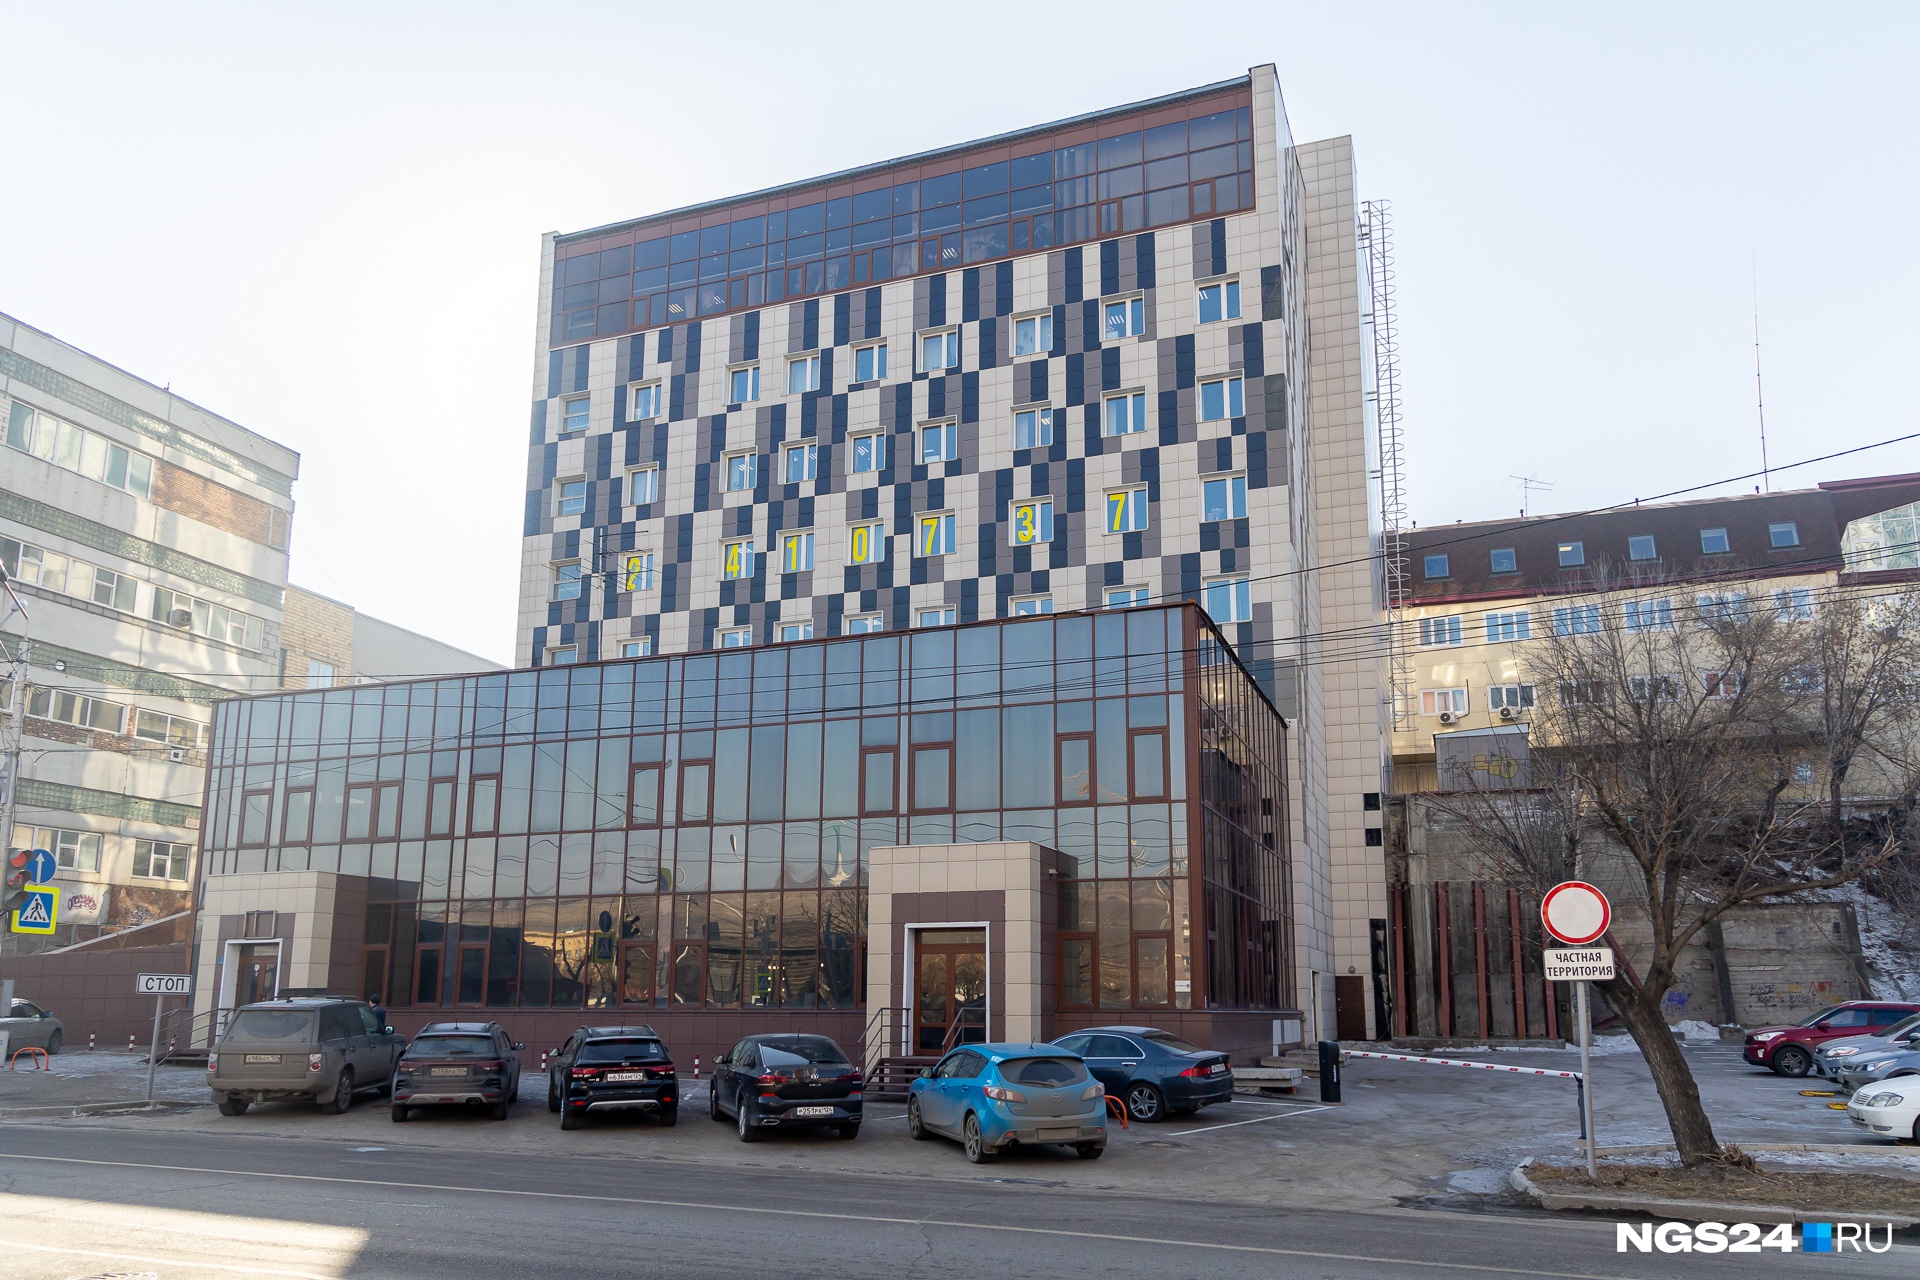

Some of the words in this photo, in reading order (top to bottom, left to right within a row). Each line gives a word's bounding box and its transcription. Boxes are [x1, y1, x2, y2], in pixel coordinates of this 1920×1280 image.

[627, 557, 641, 590] 2
[726, 544, 740, 578] 4
[786, 535, 798, 570] 1
[852, 527, 868, 563] 0
[923, 518, 938, 555] 7
[1017, 506, 1034, 543] 3
[1109, 493, 1126, 531] 7
[1555, 952, 1602, 963] ЧАСТНАЯ
[1547, 965, 1613, 977] ТЕРРИТОРИЯ
[145, 977, 185, 991] СТОП
